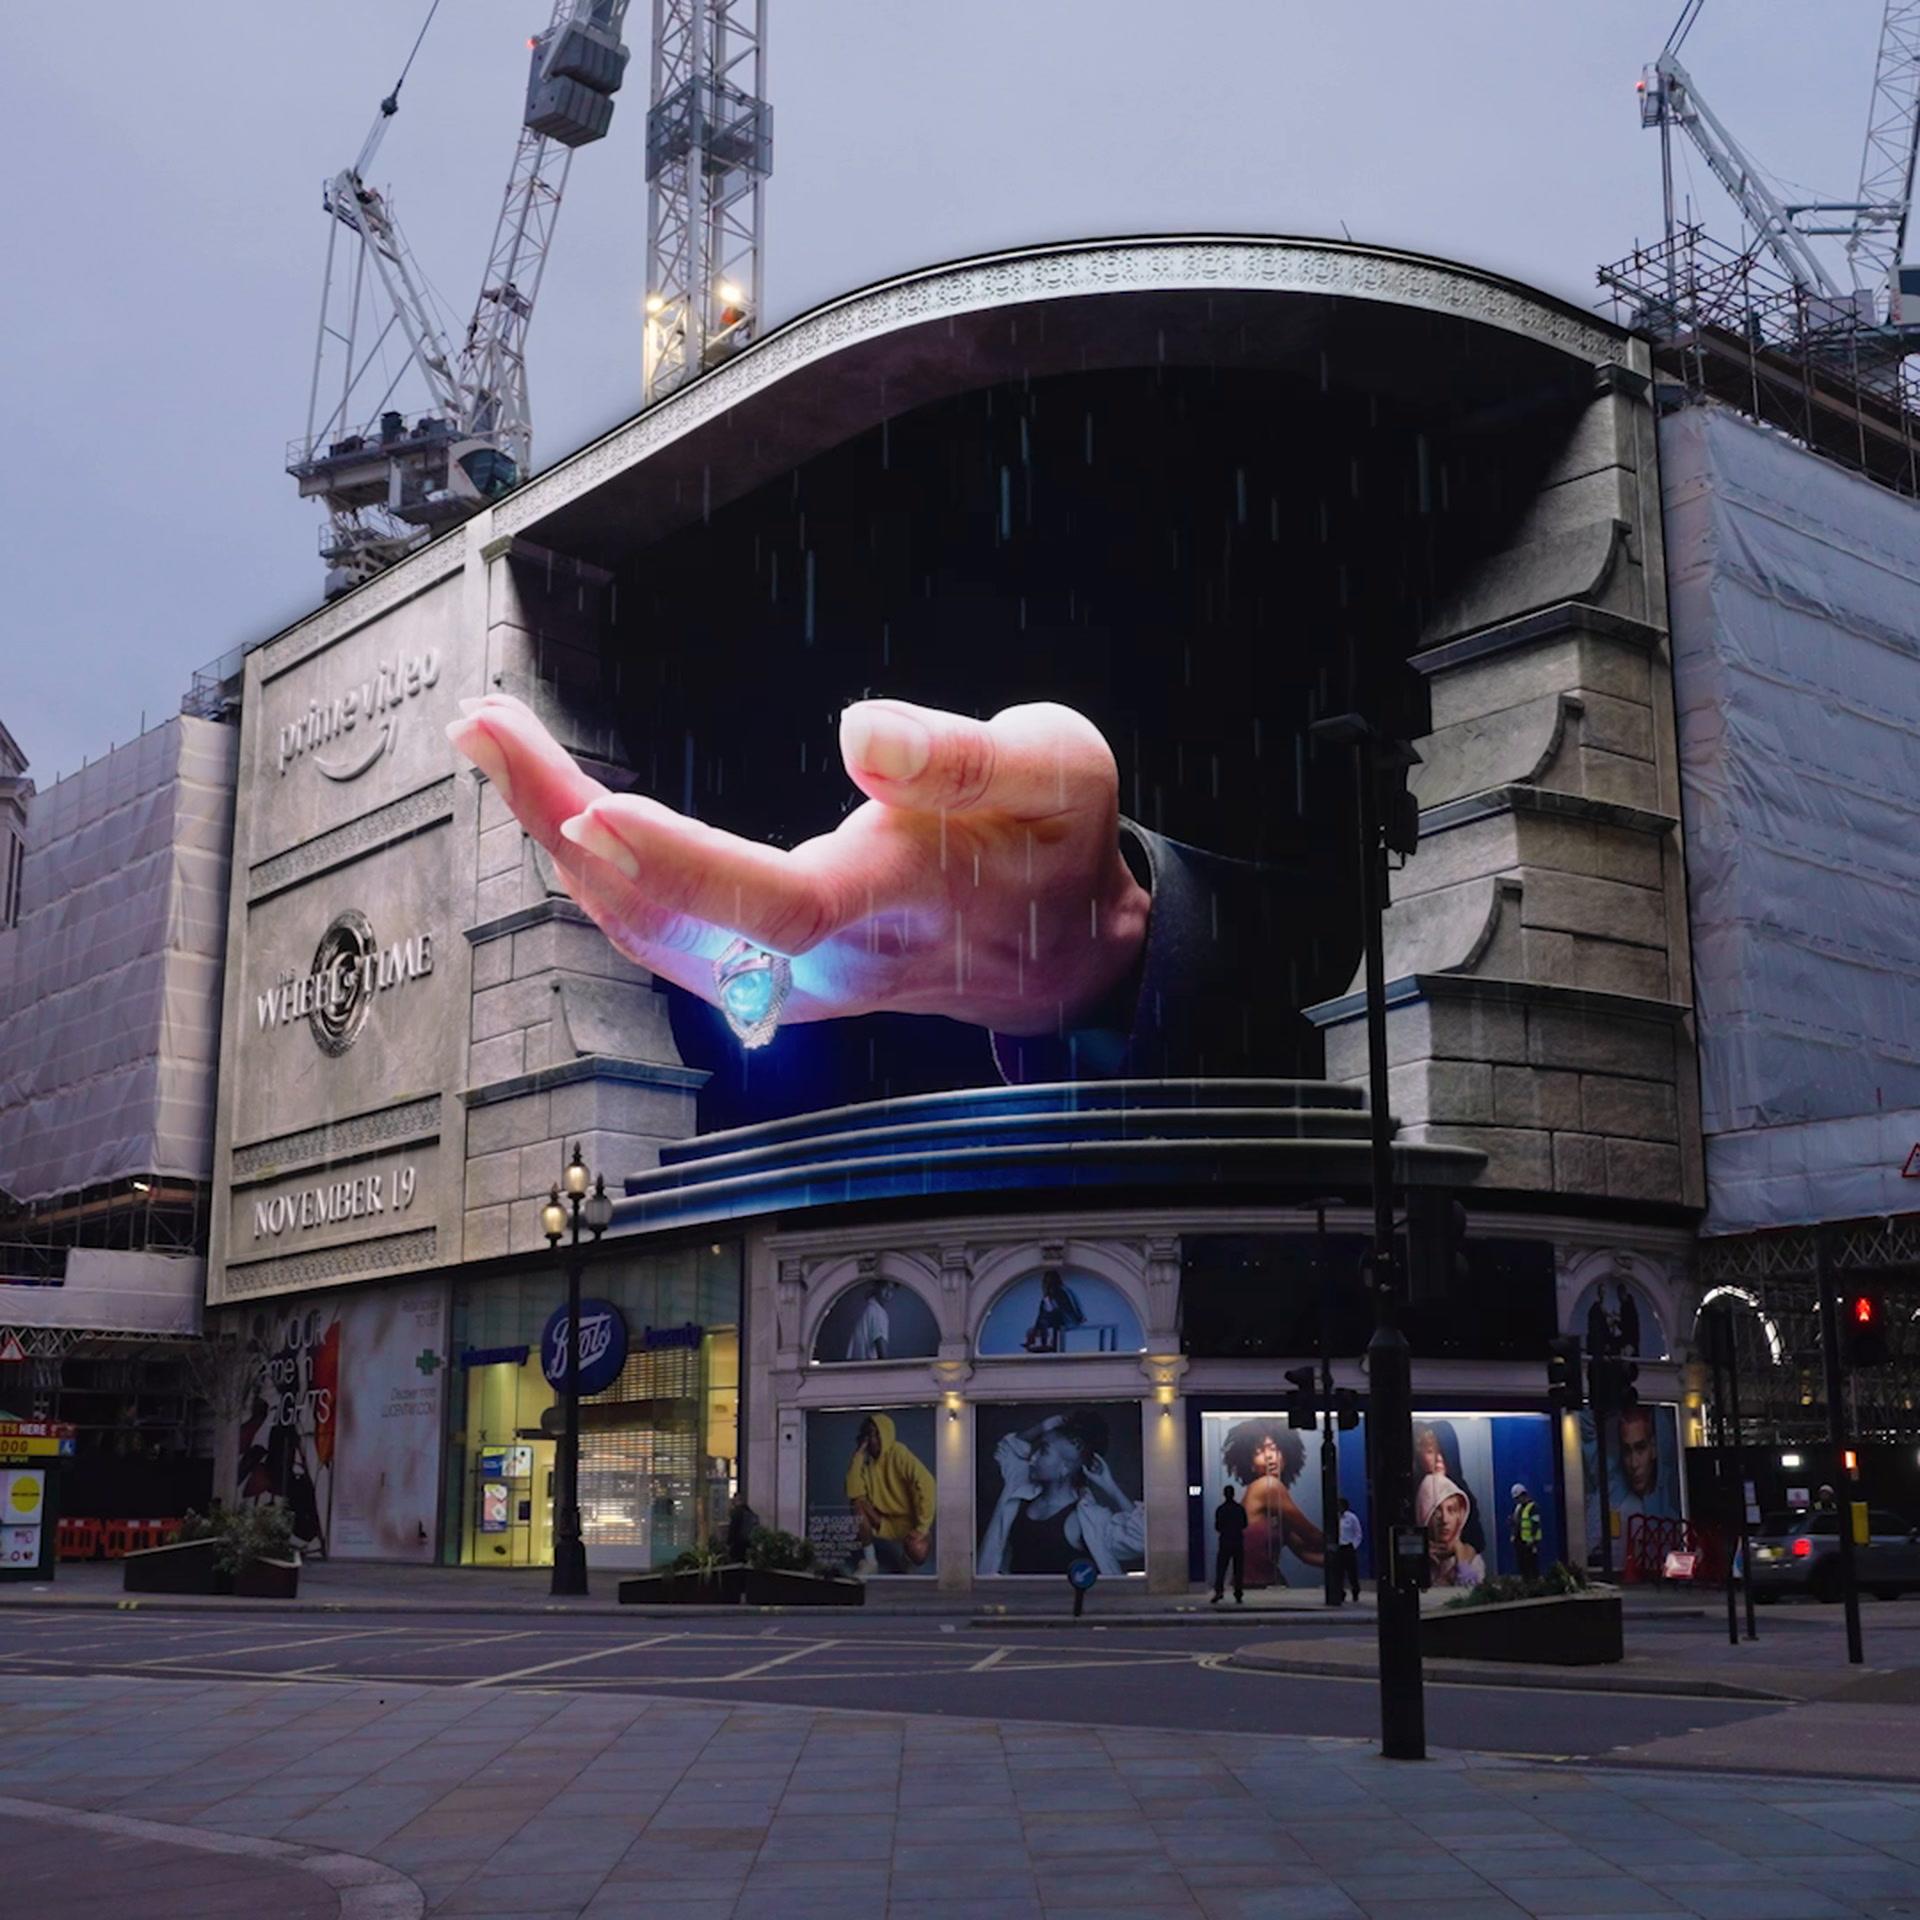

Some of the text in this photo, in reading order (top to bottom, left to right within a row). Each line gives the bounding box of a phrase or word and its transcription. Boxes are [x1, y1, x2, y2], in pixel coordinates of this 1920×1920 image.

[279, 648, 439, 776] prime video
[257, 964, 345, 1031] WHEEL
[354, 932, 433, 992] TIME
[254, 1166, 416, 1240] NOVEMBER 19
[279, 1315, 327, 1350] OUR
[546, 1312, 611, 1379] Bots
[19, 1423, 47, 1436] HERE
